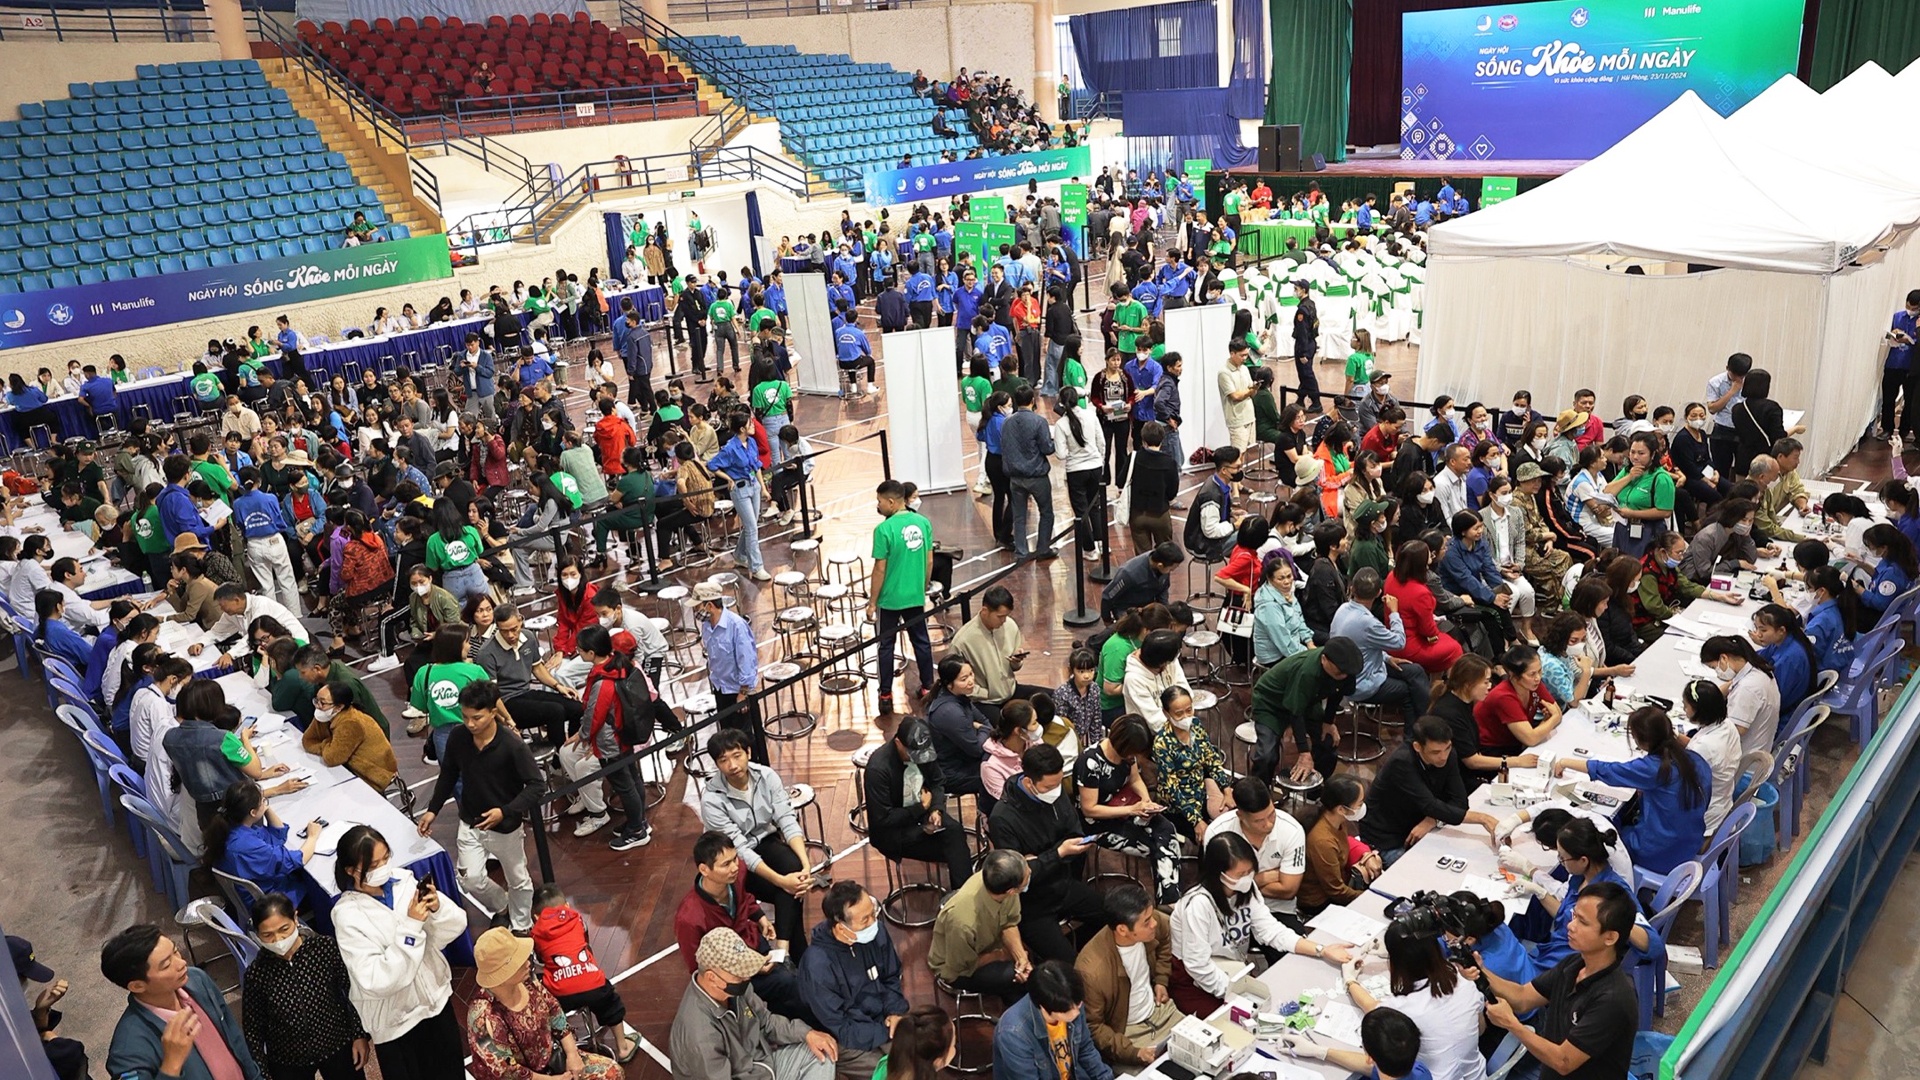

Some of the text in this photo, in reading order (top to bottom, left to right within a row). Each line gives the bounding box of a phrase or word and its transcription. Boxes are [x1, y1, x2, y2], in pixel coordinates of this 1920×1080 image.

[1662, 5, 1701, 16] Manulife
[25, 17, 43, 27] A2
[1479, 45, 1509, 55] NGÀY HỘI
[1474, 40, 1696, 77] SỐNG Khỏe MỖI NGÀY
[1650, 72, 1687, 80] 23/11/2024
[578, 106, 593, 114] VIP
[188, 260, 398, 301] NGÀY HỘI SỐNG Khỏe MỖI NGÀY
[112, 298, 155, 312] Manulife
